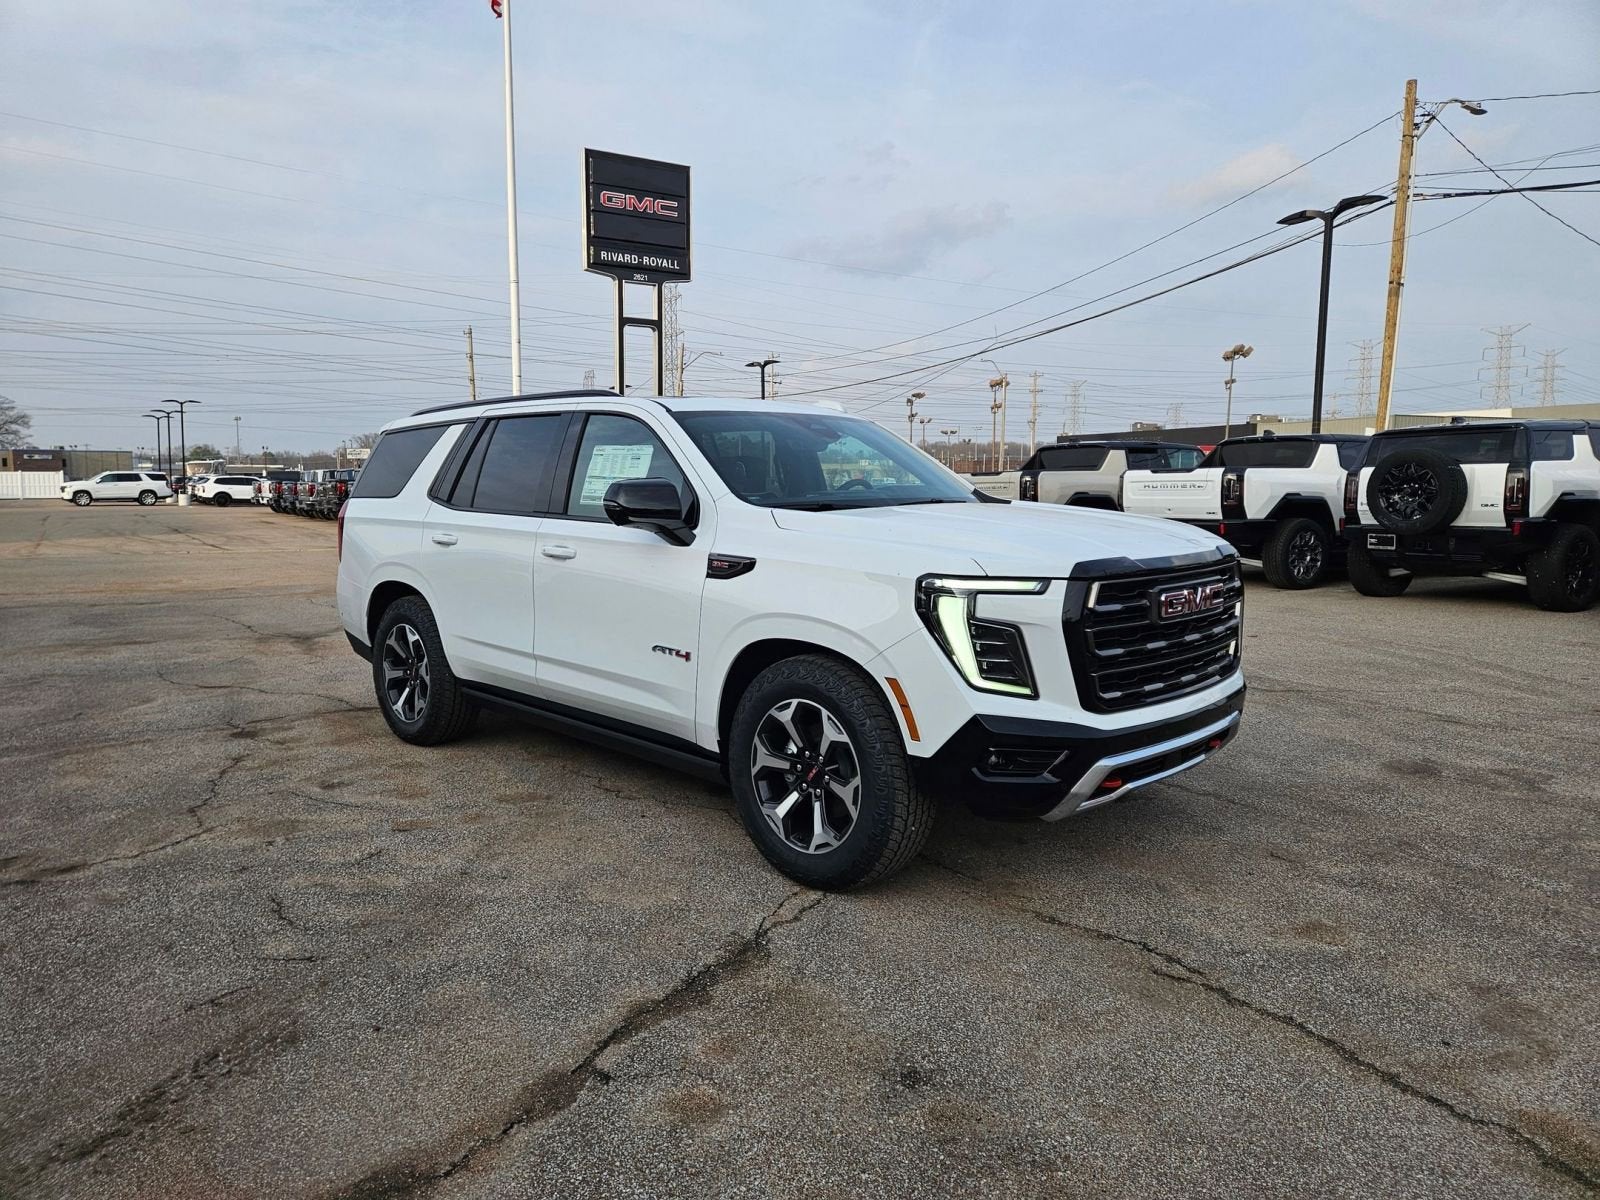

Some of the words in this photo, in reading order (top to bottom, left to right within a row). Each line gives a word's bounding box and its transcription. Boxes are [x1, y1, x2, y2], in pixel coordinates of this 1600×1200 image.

[600, 190, 679, 217] GMC
[600, 250, 680, 270] RIVARD-ROYALL
[1160, 583, 1224, 618] GMC
[651, 644, 692, 662] AT4
